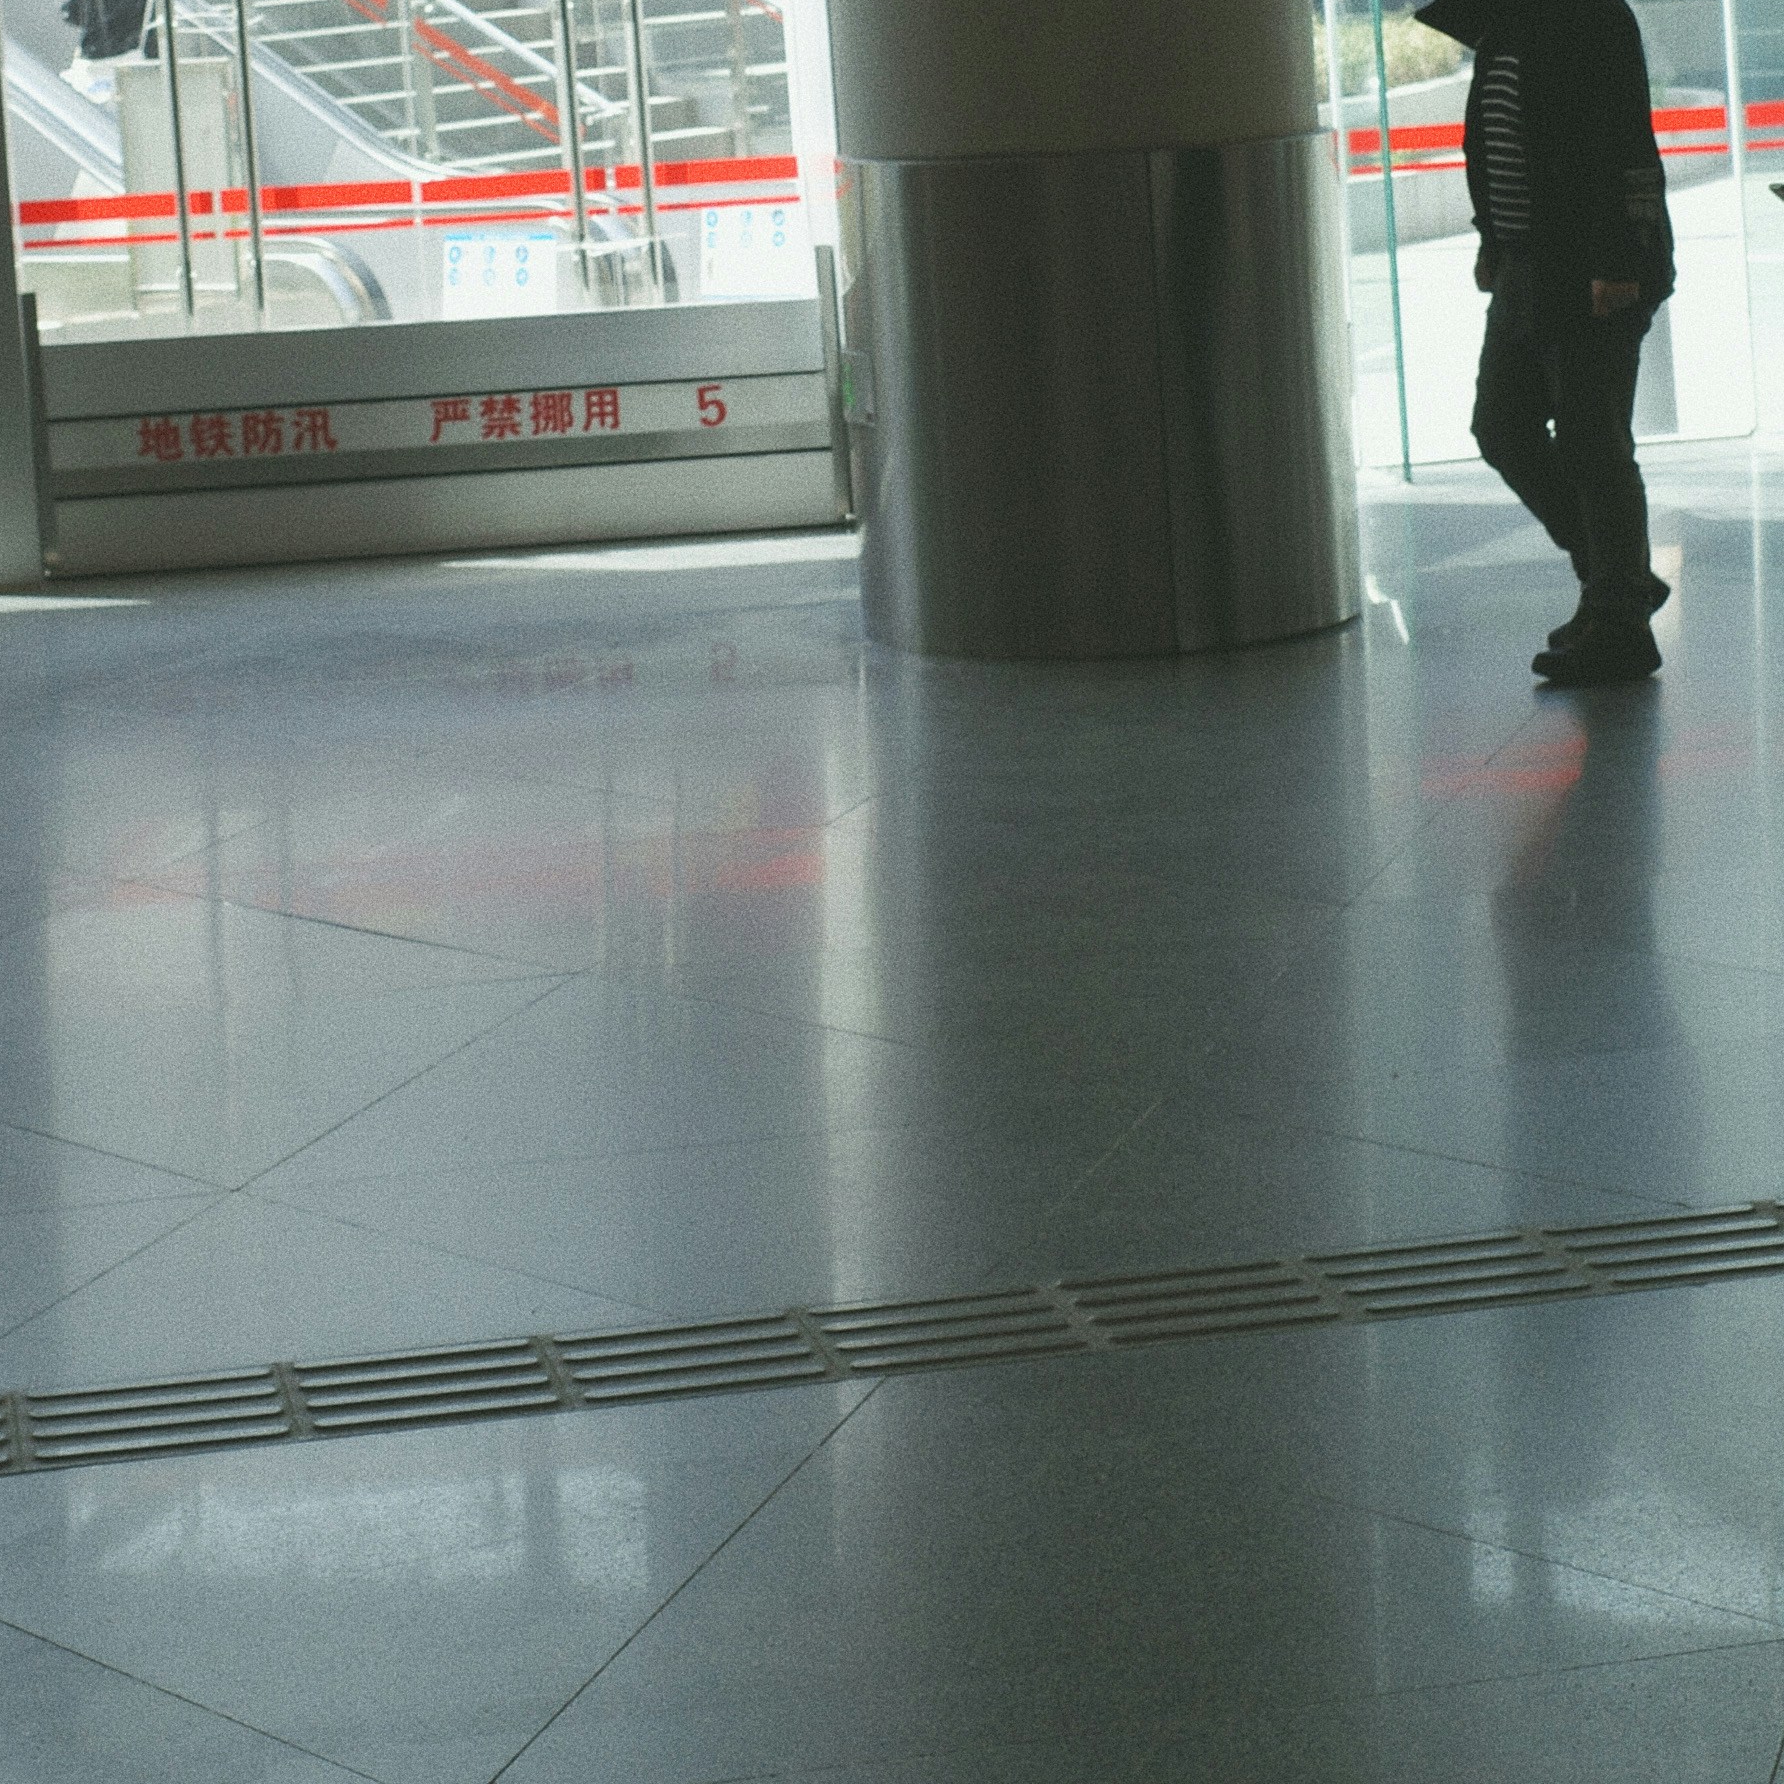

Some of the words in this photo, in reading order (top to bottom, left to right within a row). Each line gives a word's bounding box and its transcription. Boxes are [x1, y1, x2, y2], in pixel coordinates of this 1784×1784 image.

[138, 408, 339, 462] 地铁防汛
[429, 386, 622, 443] 严禁挪用
[696, 384, 729, 428] 5
